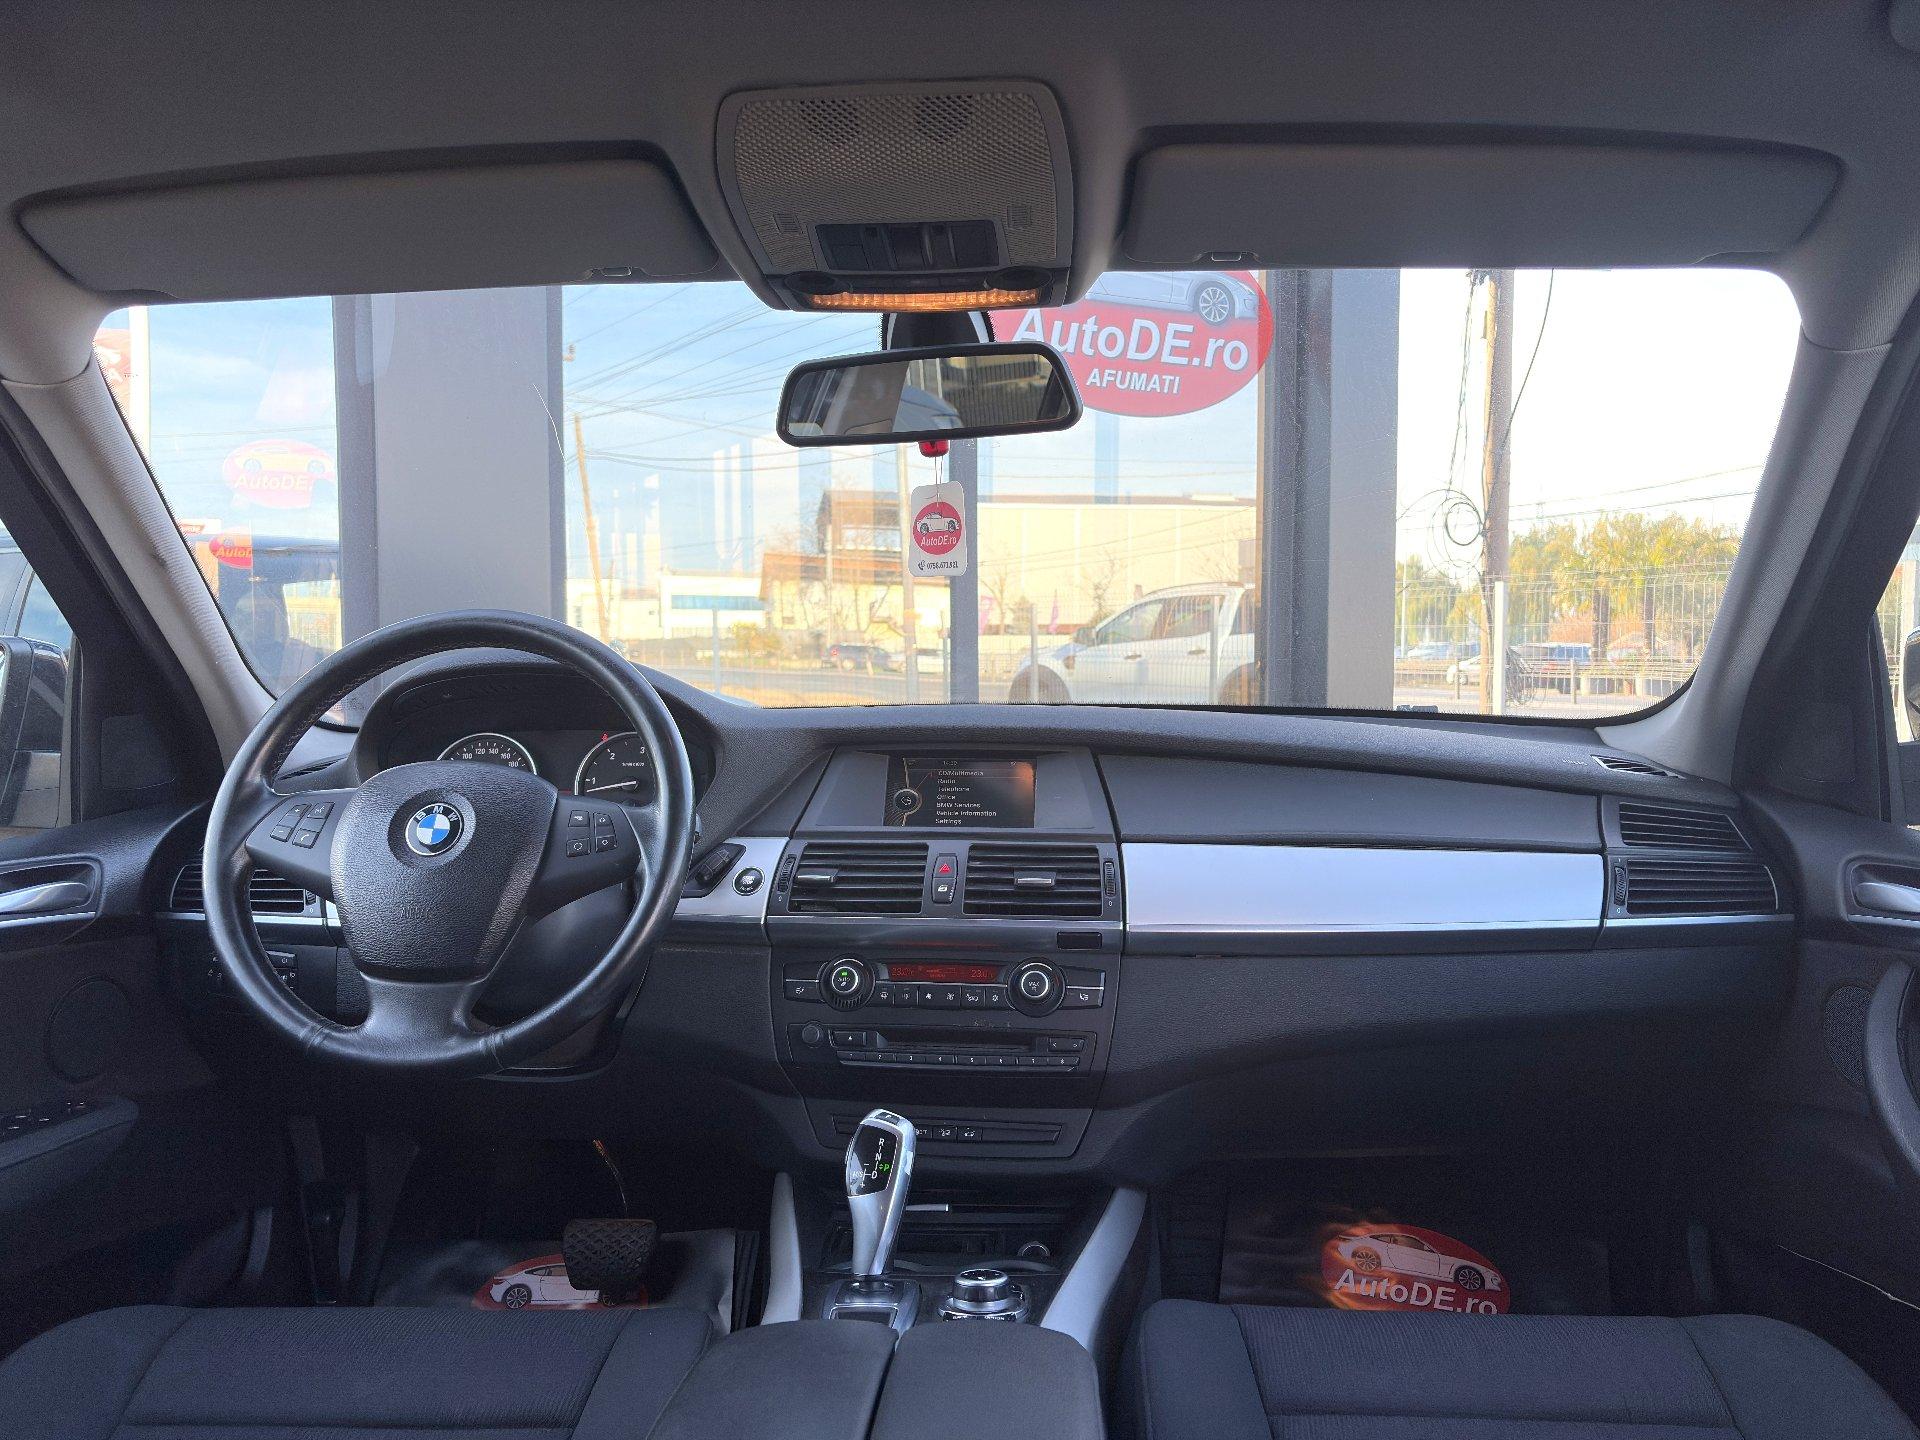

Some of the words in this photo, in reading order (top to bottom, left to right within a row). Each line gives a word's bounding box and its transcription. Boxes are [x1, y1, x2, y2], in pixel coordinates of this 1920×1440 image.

[1011, 308, 1250, 371] AutoDE.ro
[1086, 368, 1181, 395] AFUMATI
[920, 534, 957, 547] AutoDE.ro
[415, 805, 459, 822] BMW
[878, 1138, 885, 1146] R
[875, 1153, 882, 1161] N
[871, 1170, 878, 1179] D
[1334, 1268, 1498, 1315] AutoDE.ro
